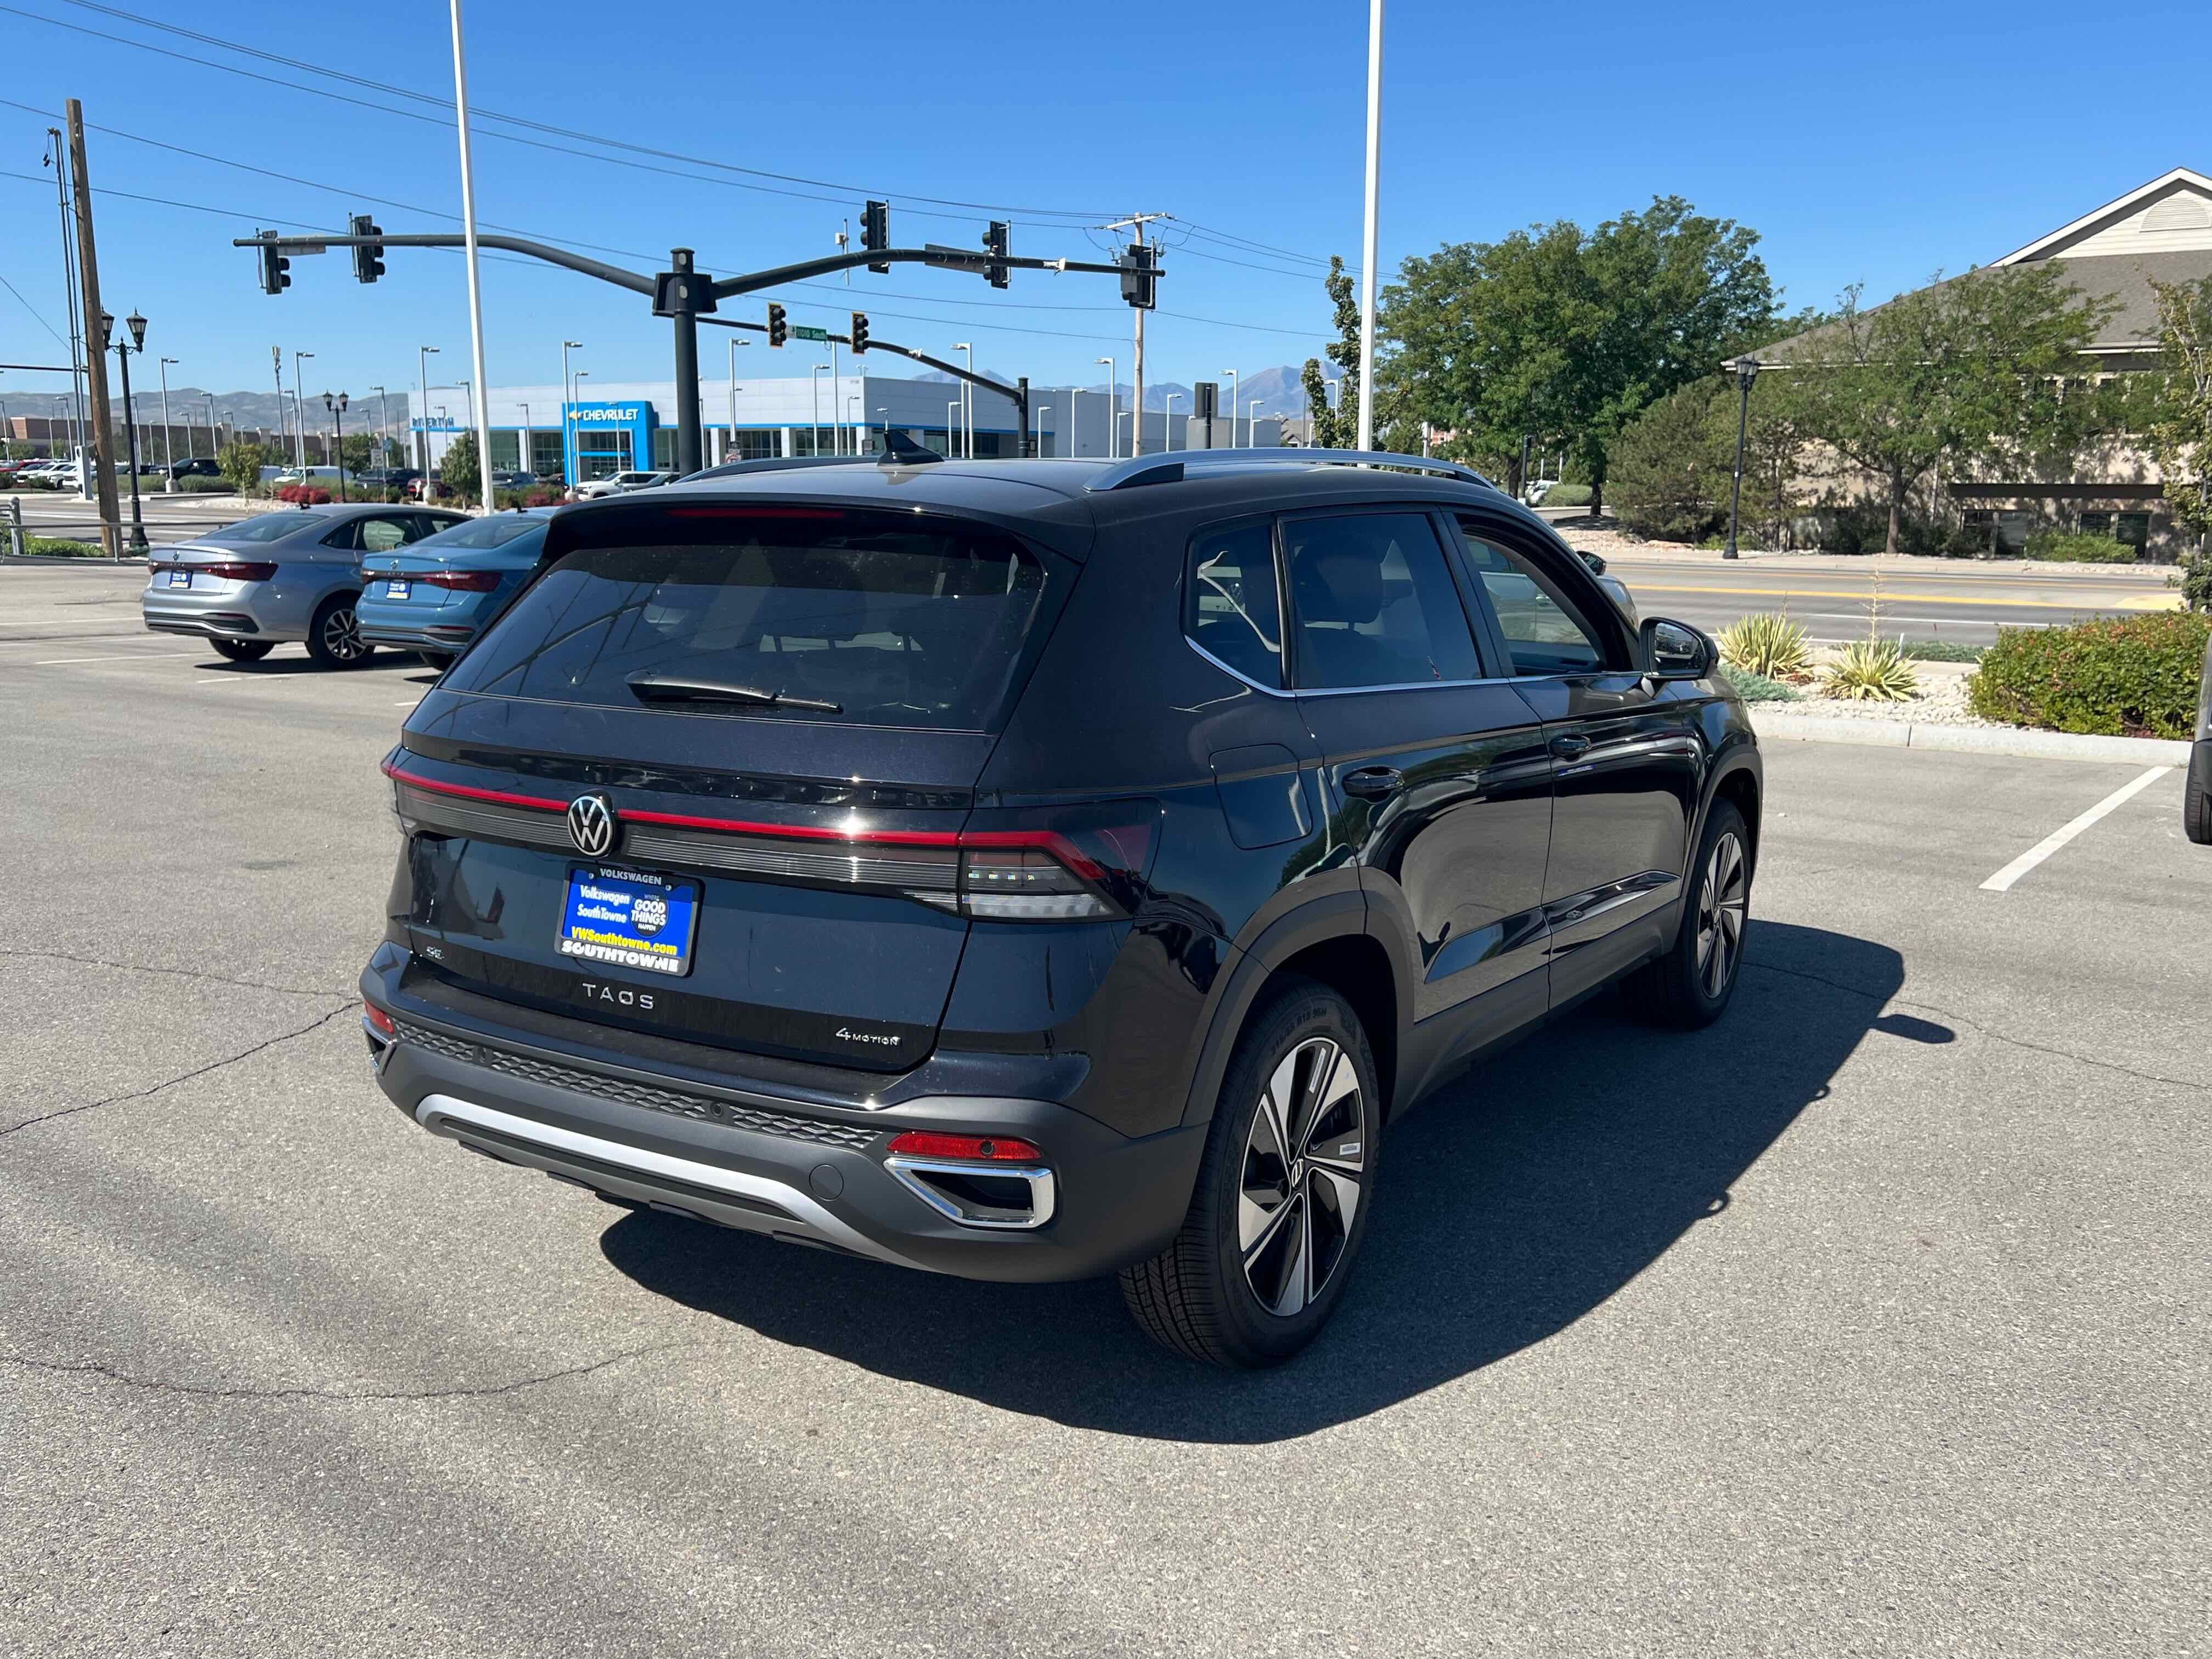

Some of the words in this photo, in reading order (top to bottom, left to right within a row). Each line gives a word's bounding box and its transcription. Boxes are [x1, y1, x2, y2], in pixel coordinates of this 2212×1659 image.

[583, 409, 638, 421] CHEVROLET
[600, 868, 662, 885] VOLKSWAGEN
[580, 885, 630, 906] Volkswagen
[634, 899, 665, 914] GOOD
[631, 910, 667, 926] THINGS
[572, 926, 677, 956] VWSouthtowne.com
[561, 940, 679, 973] SOUTHTOWNE
[582, 983, 653, 1009] TAOS
[836, 1027, 900, 1045] 4MOTION
